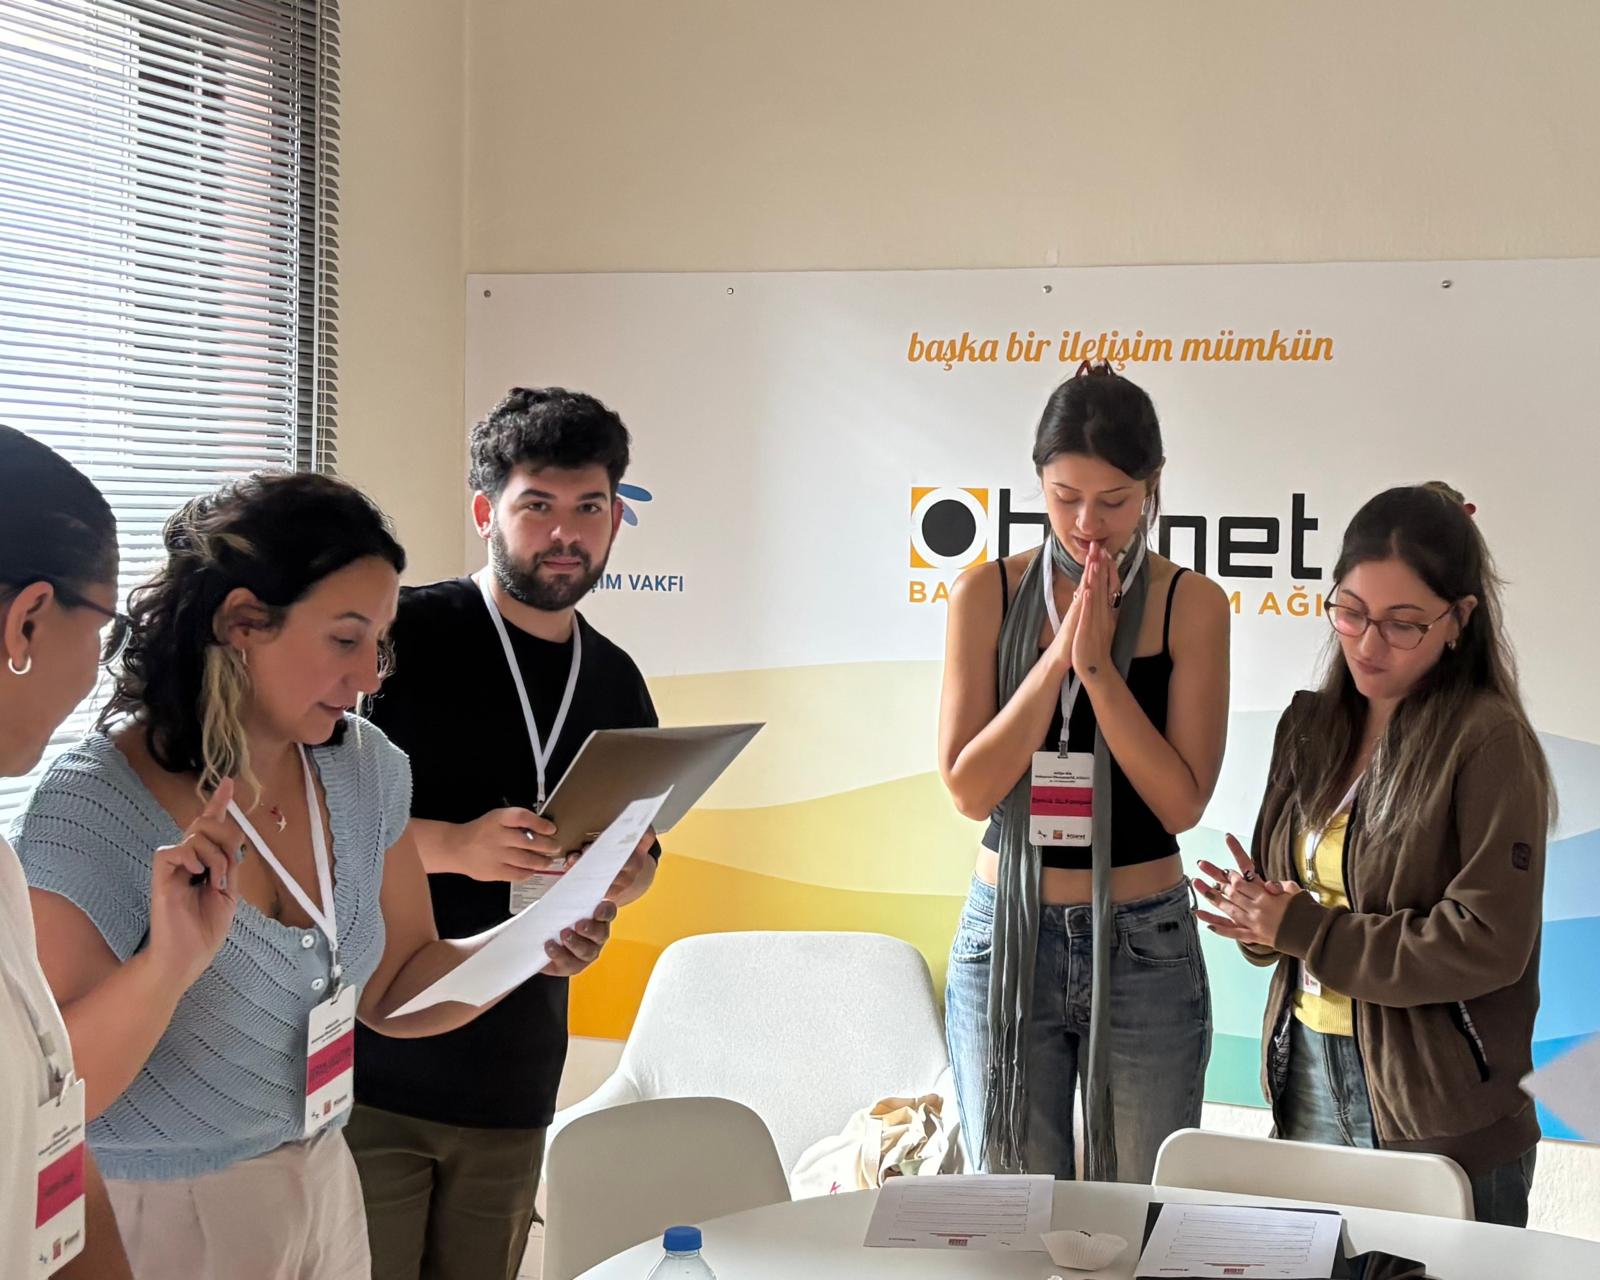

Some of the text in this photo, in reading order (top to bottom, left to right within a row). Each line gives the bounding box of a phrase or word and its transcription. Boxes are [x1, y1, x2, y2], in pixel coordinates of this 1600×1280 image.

[907, 329, 1334, 371] başka bir iletişim mümkün
[628, 574, 684, 592] VAKFI
[1258, 585, 1322, 617] AĞI
